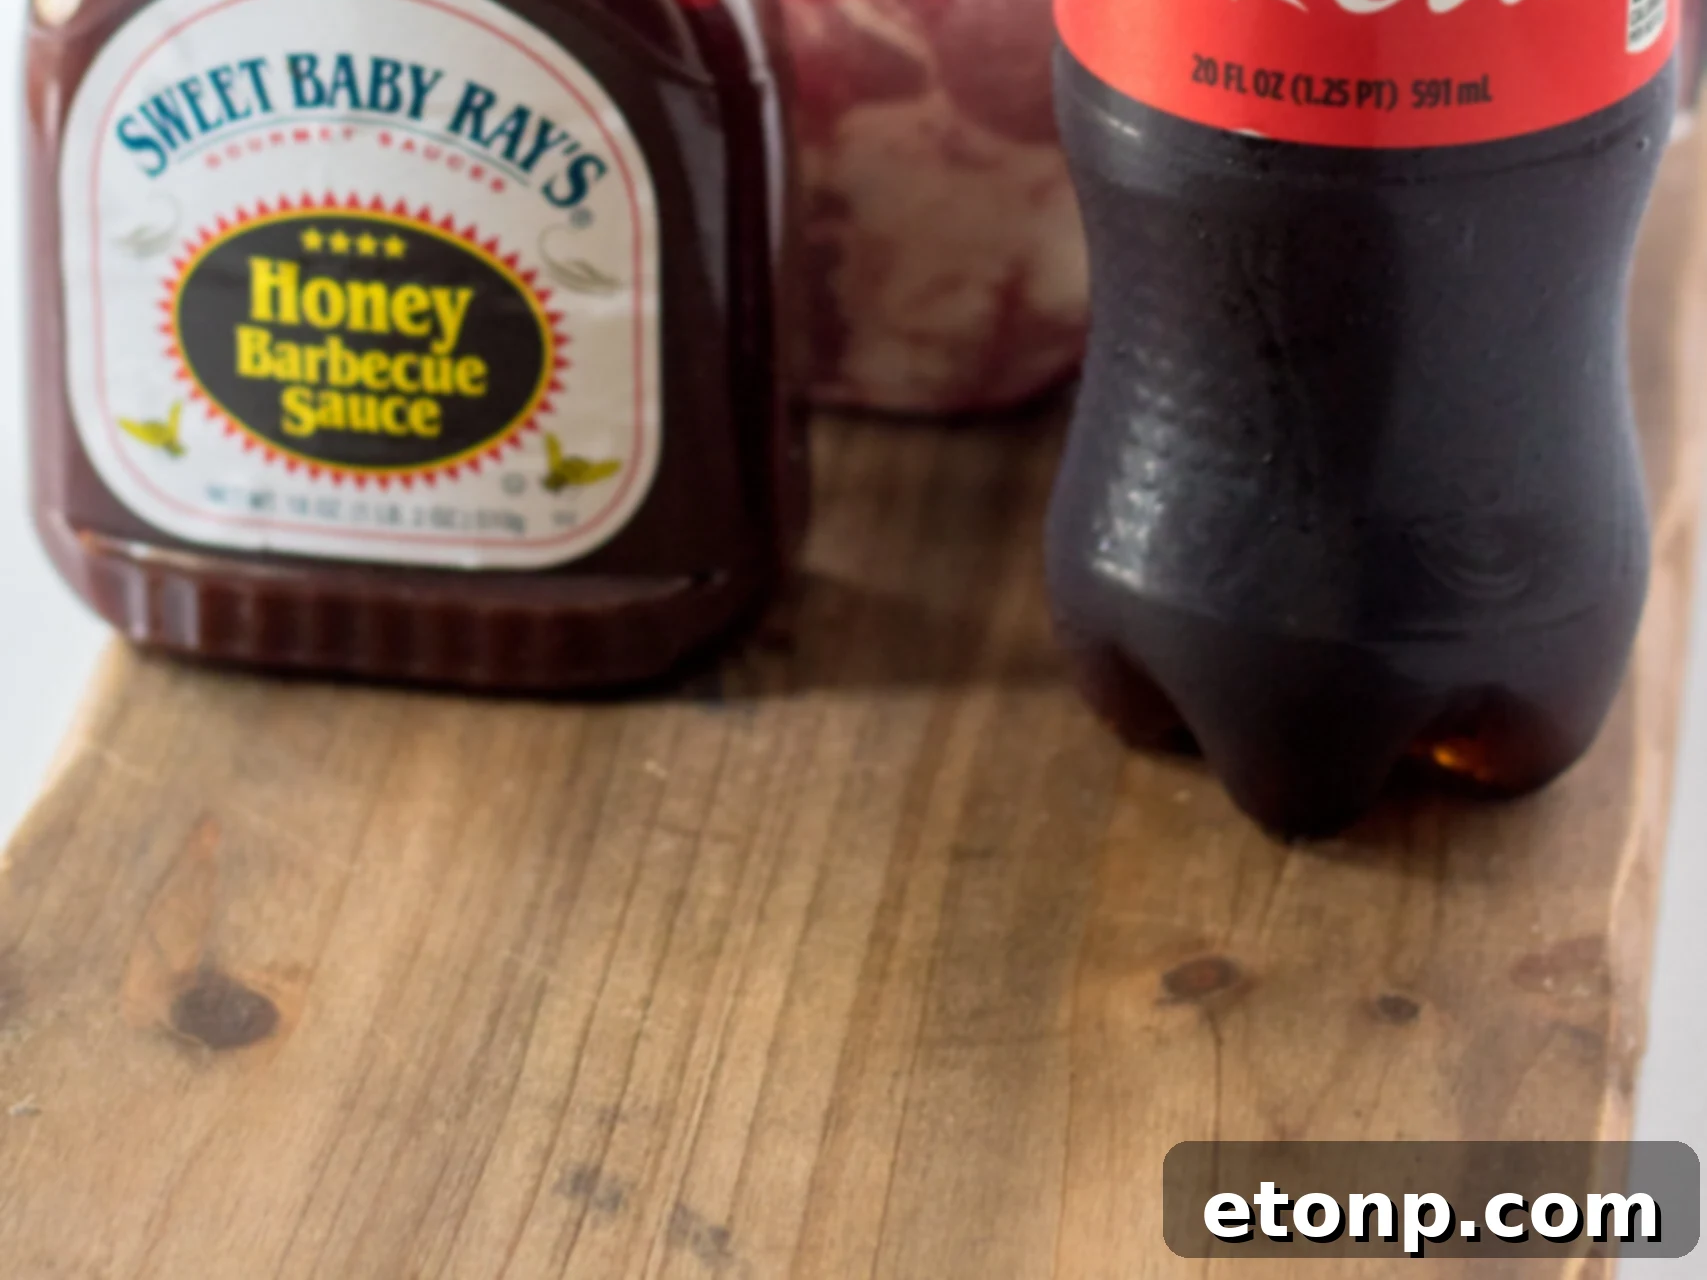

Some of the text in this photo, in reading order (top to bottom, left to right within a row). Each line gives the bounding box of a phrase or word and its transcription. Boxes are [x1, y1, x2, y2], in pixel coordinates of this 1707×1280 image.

[1191, 52, 1493, 111] 20 FL OZ (1.25 PT) 591 mL
[116, 53, 607, 209] SWEET BABY RAY'S
[248, 256, 473, 354] Honey
[235, 326, 486, 395] Barbecue
[281, 386, 442, 437] Sauce
